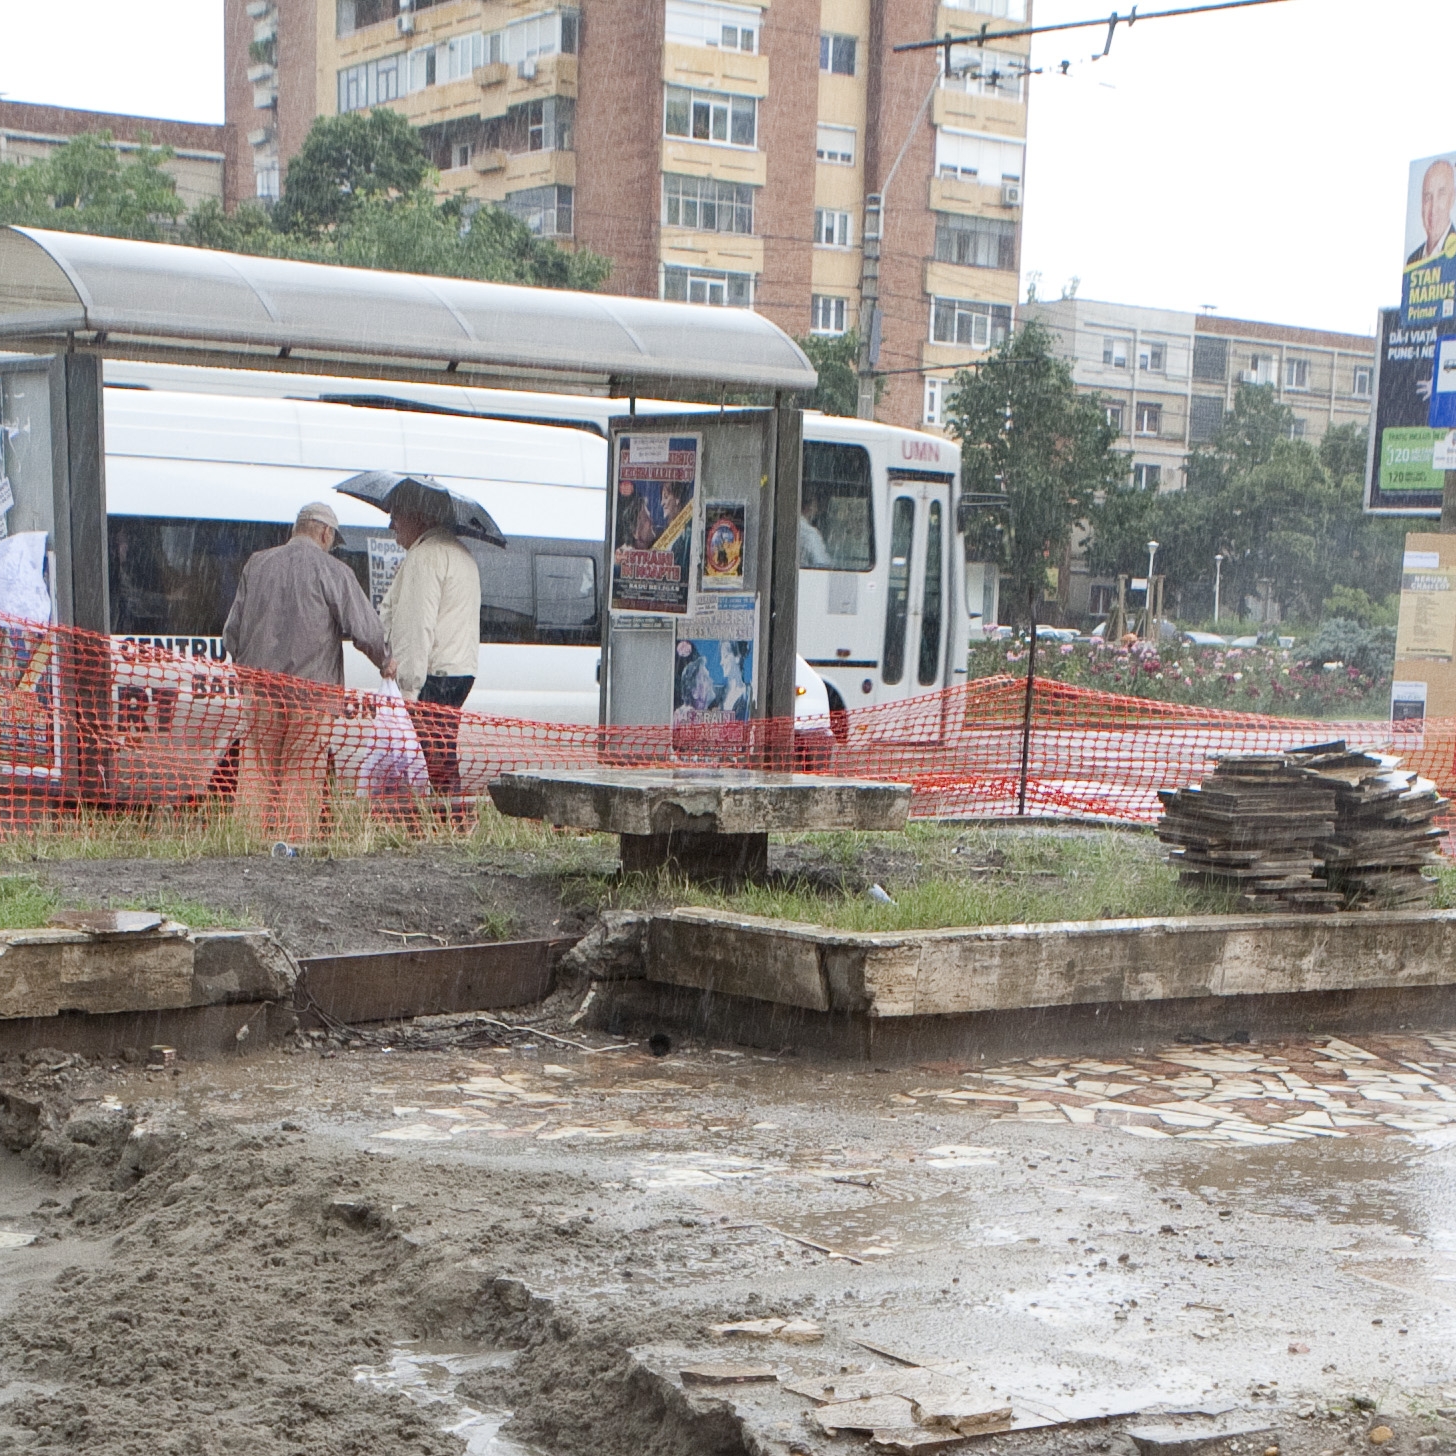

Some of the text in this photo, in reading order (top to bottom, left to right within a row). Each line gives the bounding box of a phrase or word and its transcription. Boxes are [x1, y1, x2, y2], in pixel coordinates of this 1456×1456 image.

[1410, 266, 1442, 288] STAN
[1409, 280, 1455, 305] MARIUS
[1408, 306, 1437, 321] Primar
